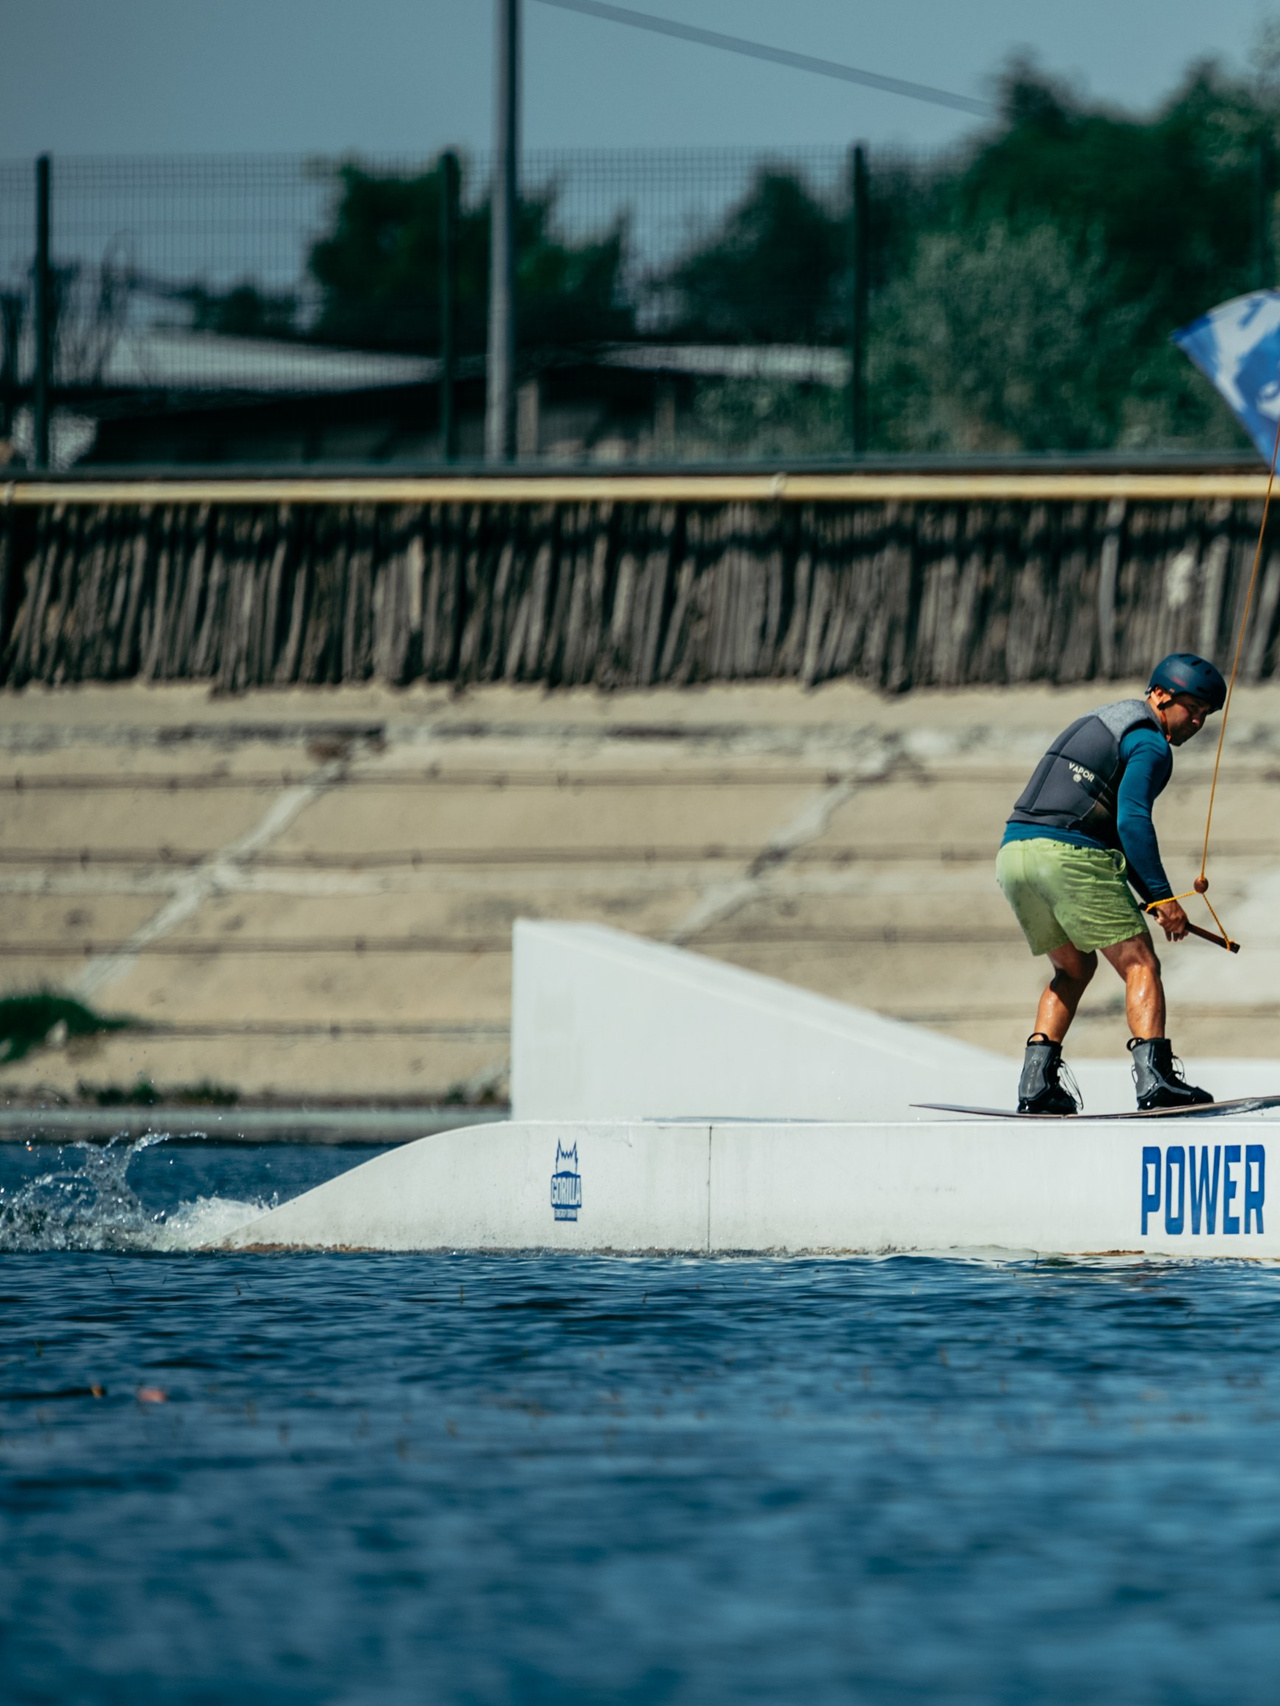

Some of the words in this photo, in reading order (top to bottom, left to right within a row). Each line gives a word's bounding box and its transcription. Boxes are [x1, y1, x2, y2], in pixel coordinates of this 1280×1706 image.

[1068, 762, 1095, 783] VAPOR
[551, 1176, 582, 1205] GORILLA
[1141, 1143, 1265, 1235] POWER
